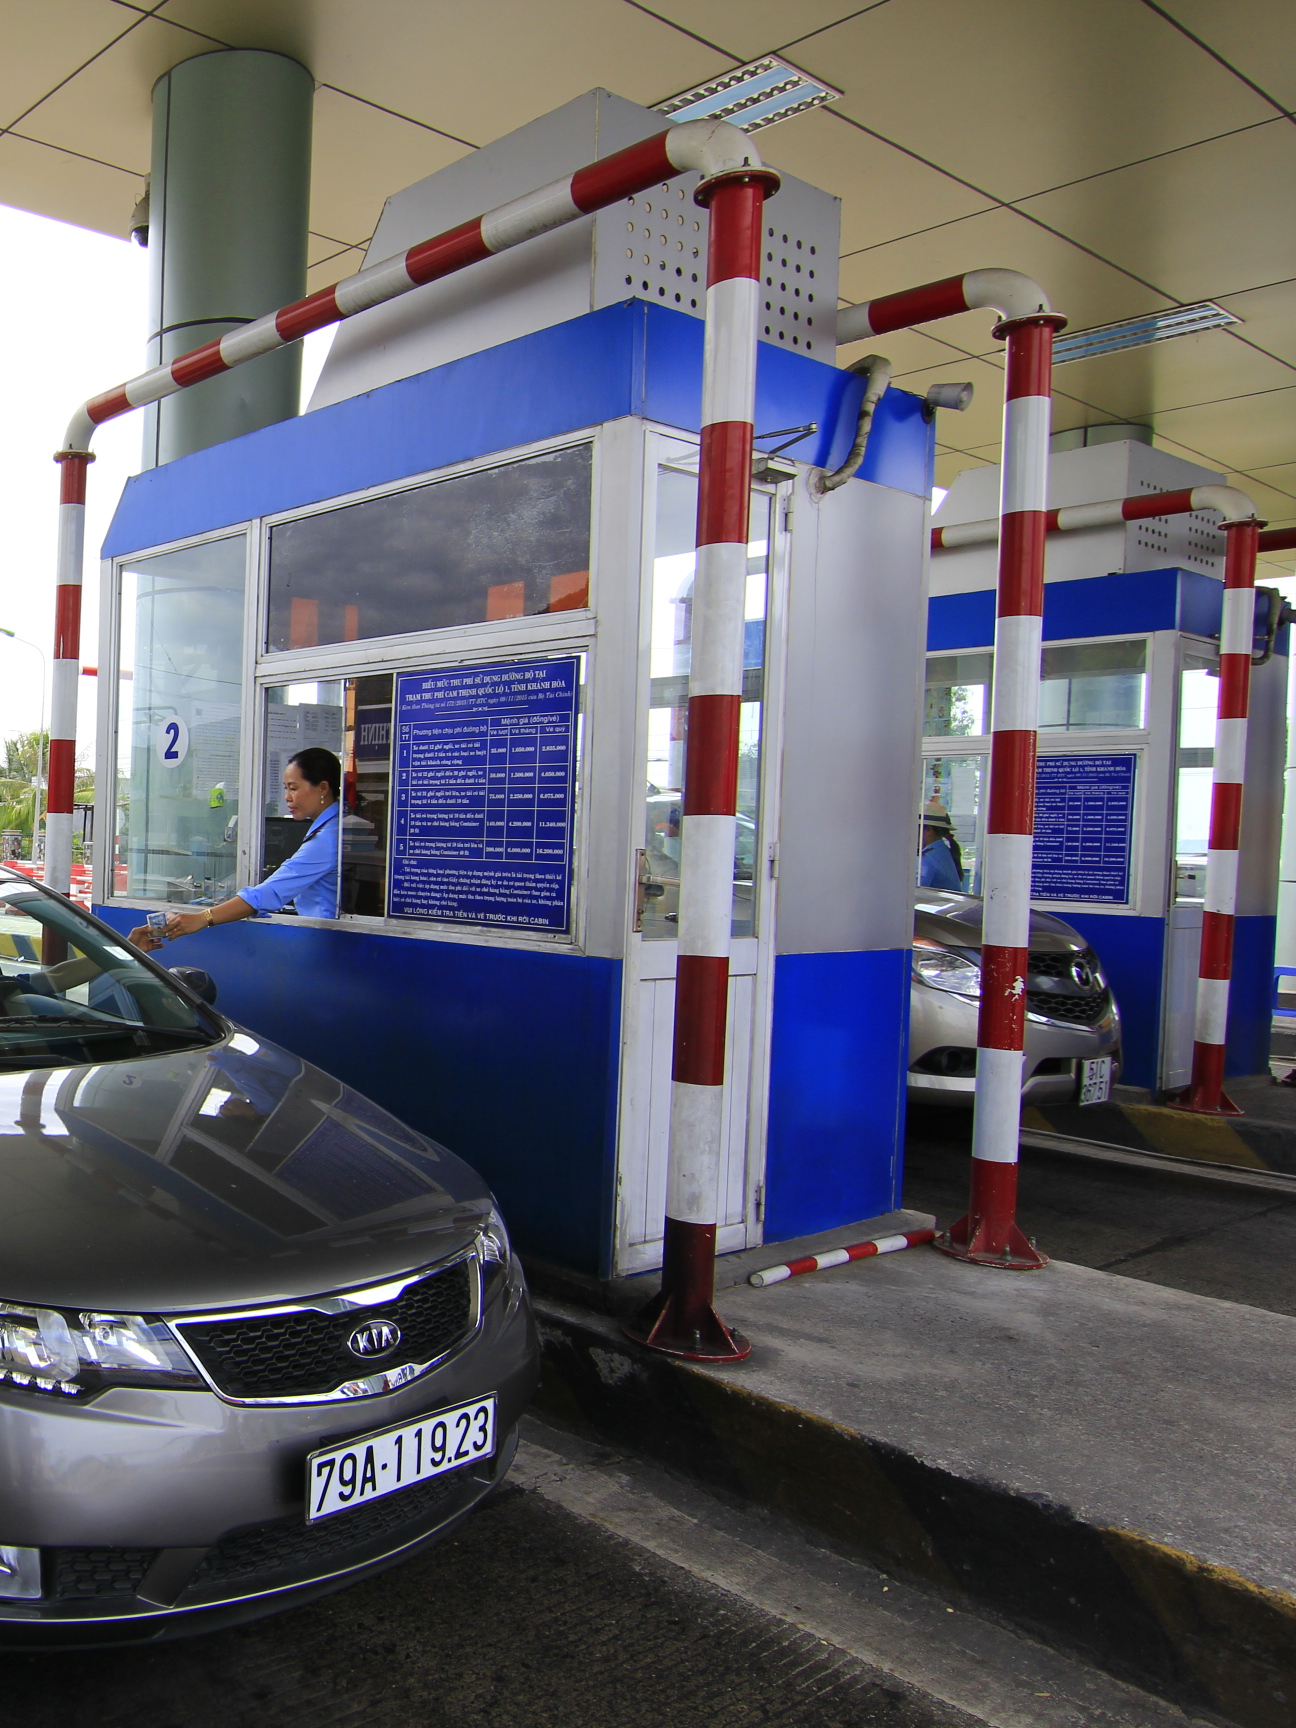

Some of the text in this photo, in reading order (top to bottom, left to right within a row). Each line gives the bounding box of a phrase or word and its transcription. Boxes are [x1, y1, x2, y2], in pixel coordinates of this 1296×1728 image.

[164, 722, 179, 760] 2
[356, 1326, 394, 1353] KIA
[317, 1406, 489, 1512] 79A-119.23
